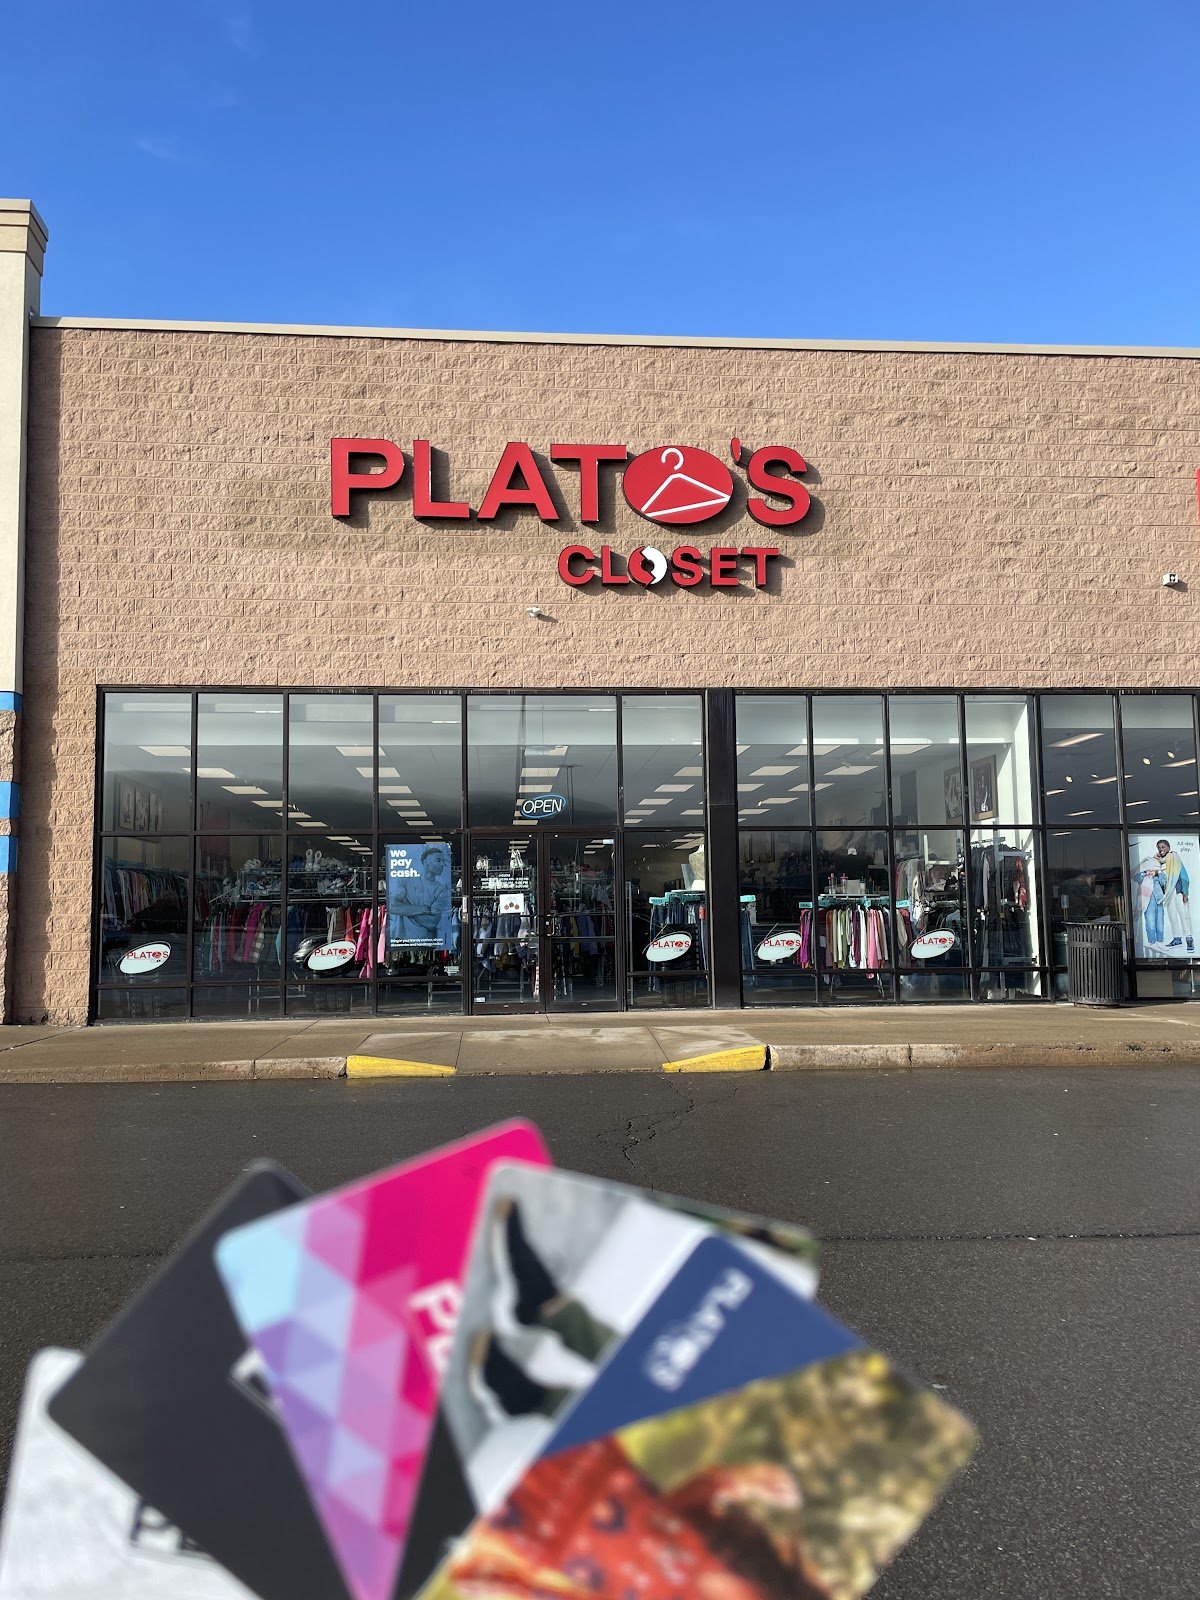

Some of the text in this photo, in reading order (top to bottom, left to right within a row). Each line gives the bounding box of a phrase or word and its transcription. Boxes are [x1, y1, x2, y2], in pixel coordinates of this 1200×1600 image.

[331, 437, 811, 526] PLATO'S
[557, 545, 780, 587] CLOSET
[523, 799, 562, 813] OPEN
[390, 858, 412, 869] pay
[390, 868, 420, 877] cash.
